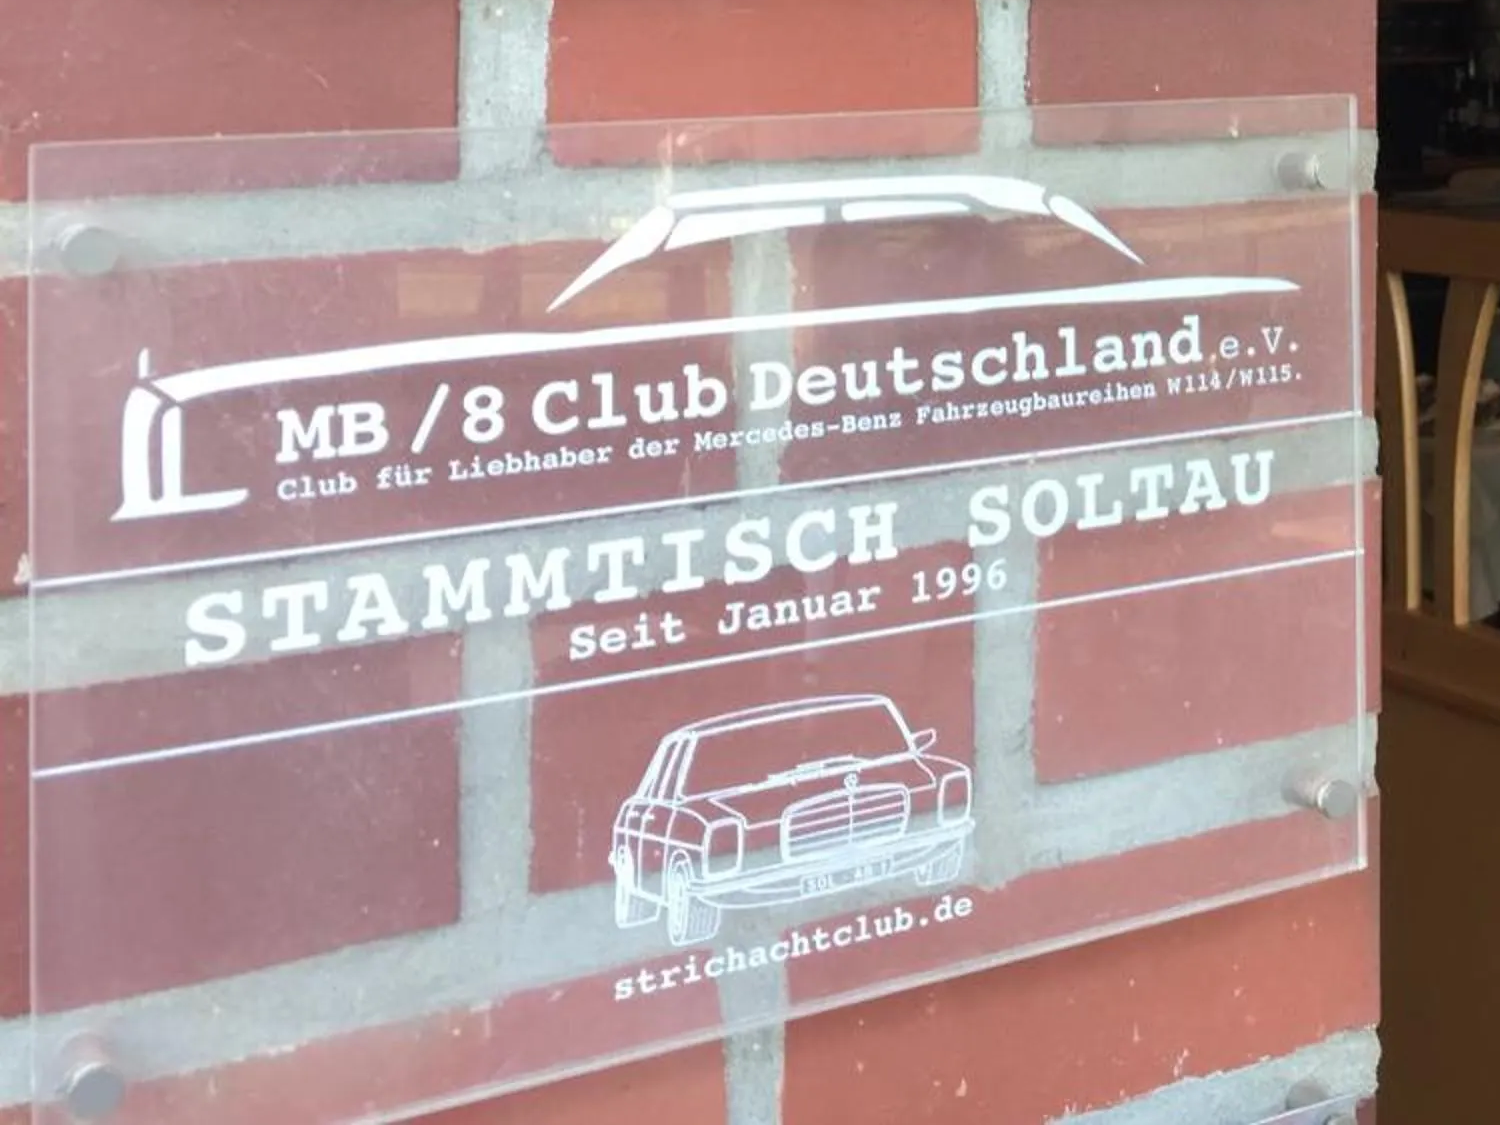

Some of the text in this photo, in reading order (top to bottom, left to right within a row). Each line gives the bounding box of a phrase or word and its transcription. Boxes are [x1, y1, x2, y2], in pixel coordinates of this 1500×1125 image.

[275, 402, 390, 463] MB
[531, 364, 728, 436] Club
[749, 315, 1204, 412] Deutschland
[1218, 325, 1299, 360] e.V.
[277, 472, 358, 501] Club
[376, 466, 433, 490] für
[448, 444, 613, 481] Liebhaber
[628, 435, 679, 460] der
[694, 412, 902, 452] Mercedes-Benz
[915, 379, 1157, 426] Fahrzeugbaureihen
[184, 449, 1276, 667] STAMMTISCH SOLTAU
[568, 558, 1008, 662] Seit Januar 1996
[613, 896, 974, 1001] strichachtclub.de
